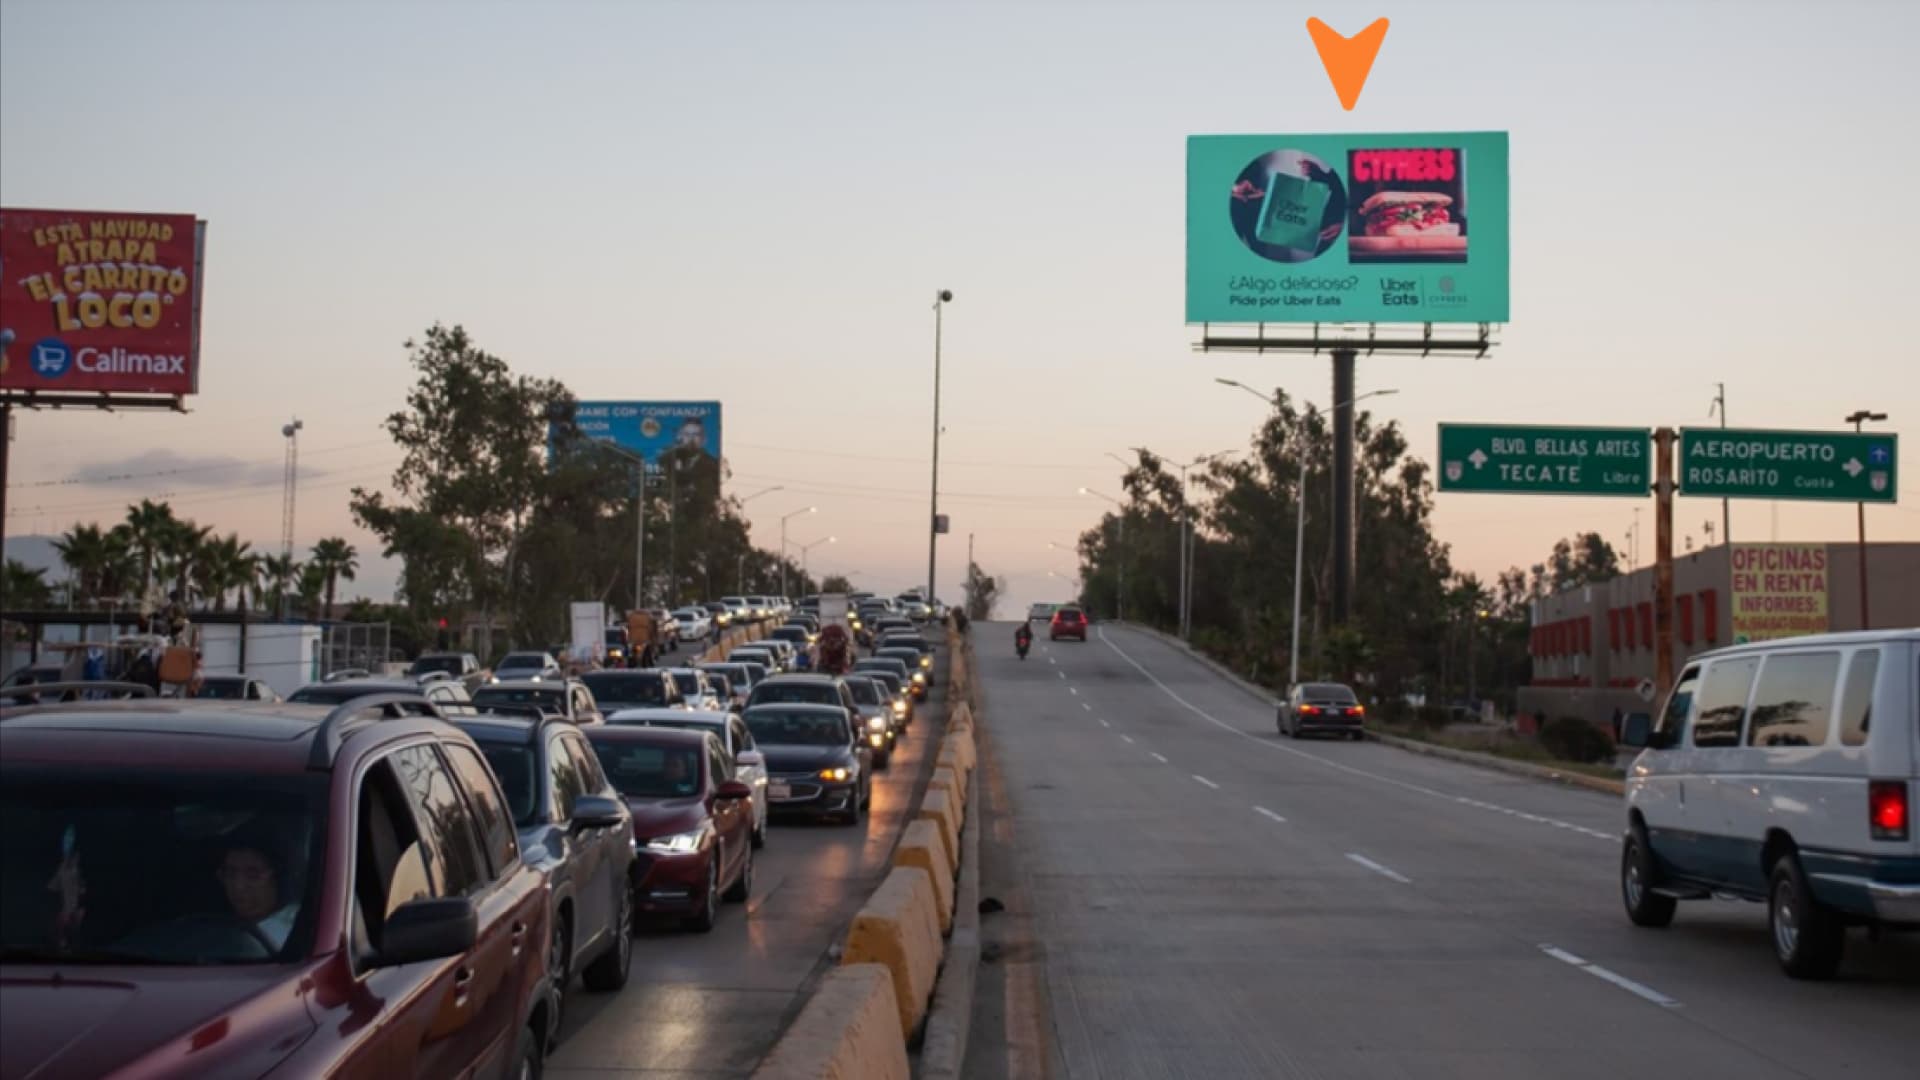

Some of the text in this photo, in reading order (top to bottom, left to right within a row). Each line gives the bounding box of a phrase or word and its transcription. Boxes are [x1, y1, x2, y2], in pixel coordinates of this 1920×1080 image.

[1353, 148, 1455, 182] CYPRESS
[34, 220, 173, 247] ESTA NAVIDAD
[57, 240, 156, 265] ATRAPA
[64, 262, 187, 295] CARRITO
[1229, 275, 1359, 294] ¿Algo delicioso?
[1380, 278, 1416, 291] Uber
[1229, 295, 1341, 308] Pide por Uber Eats
[1382, 293, 1419, 306] Eats
[76, 347, 185, 374] Calimax
[1535, 438, 1588, 456] BELLAS
[1595, 440, 1641, 458] ARTES
[1690, 440, 1836, 462] AEROPUERTO
[1500, 464, 1640, 484] TECATE Libre
[1689, 467, 1835, 488] ROSARITO Cuota
[1732, 547, 1826, 571] OFICINAS
[1733, 573, 1826, 592] EN RENTA
[1740, 596, 1818, 613] INFORMES:
